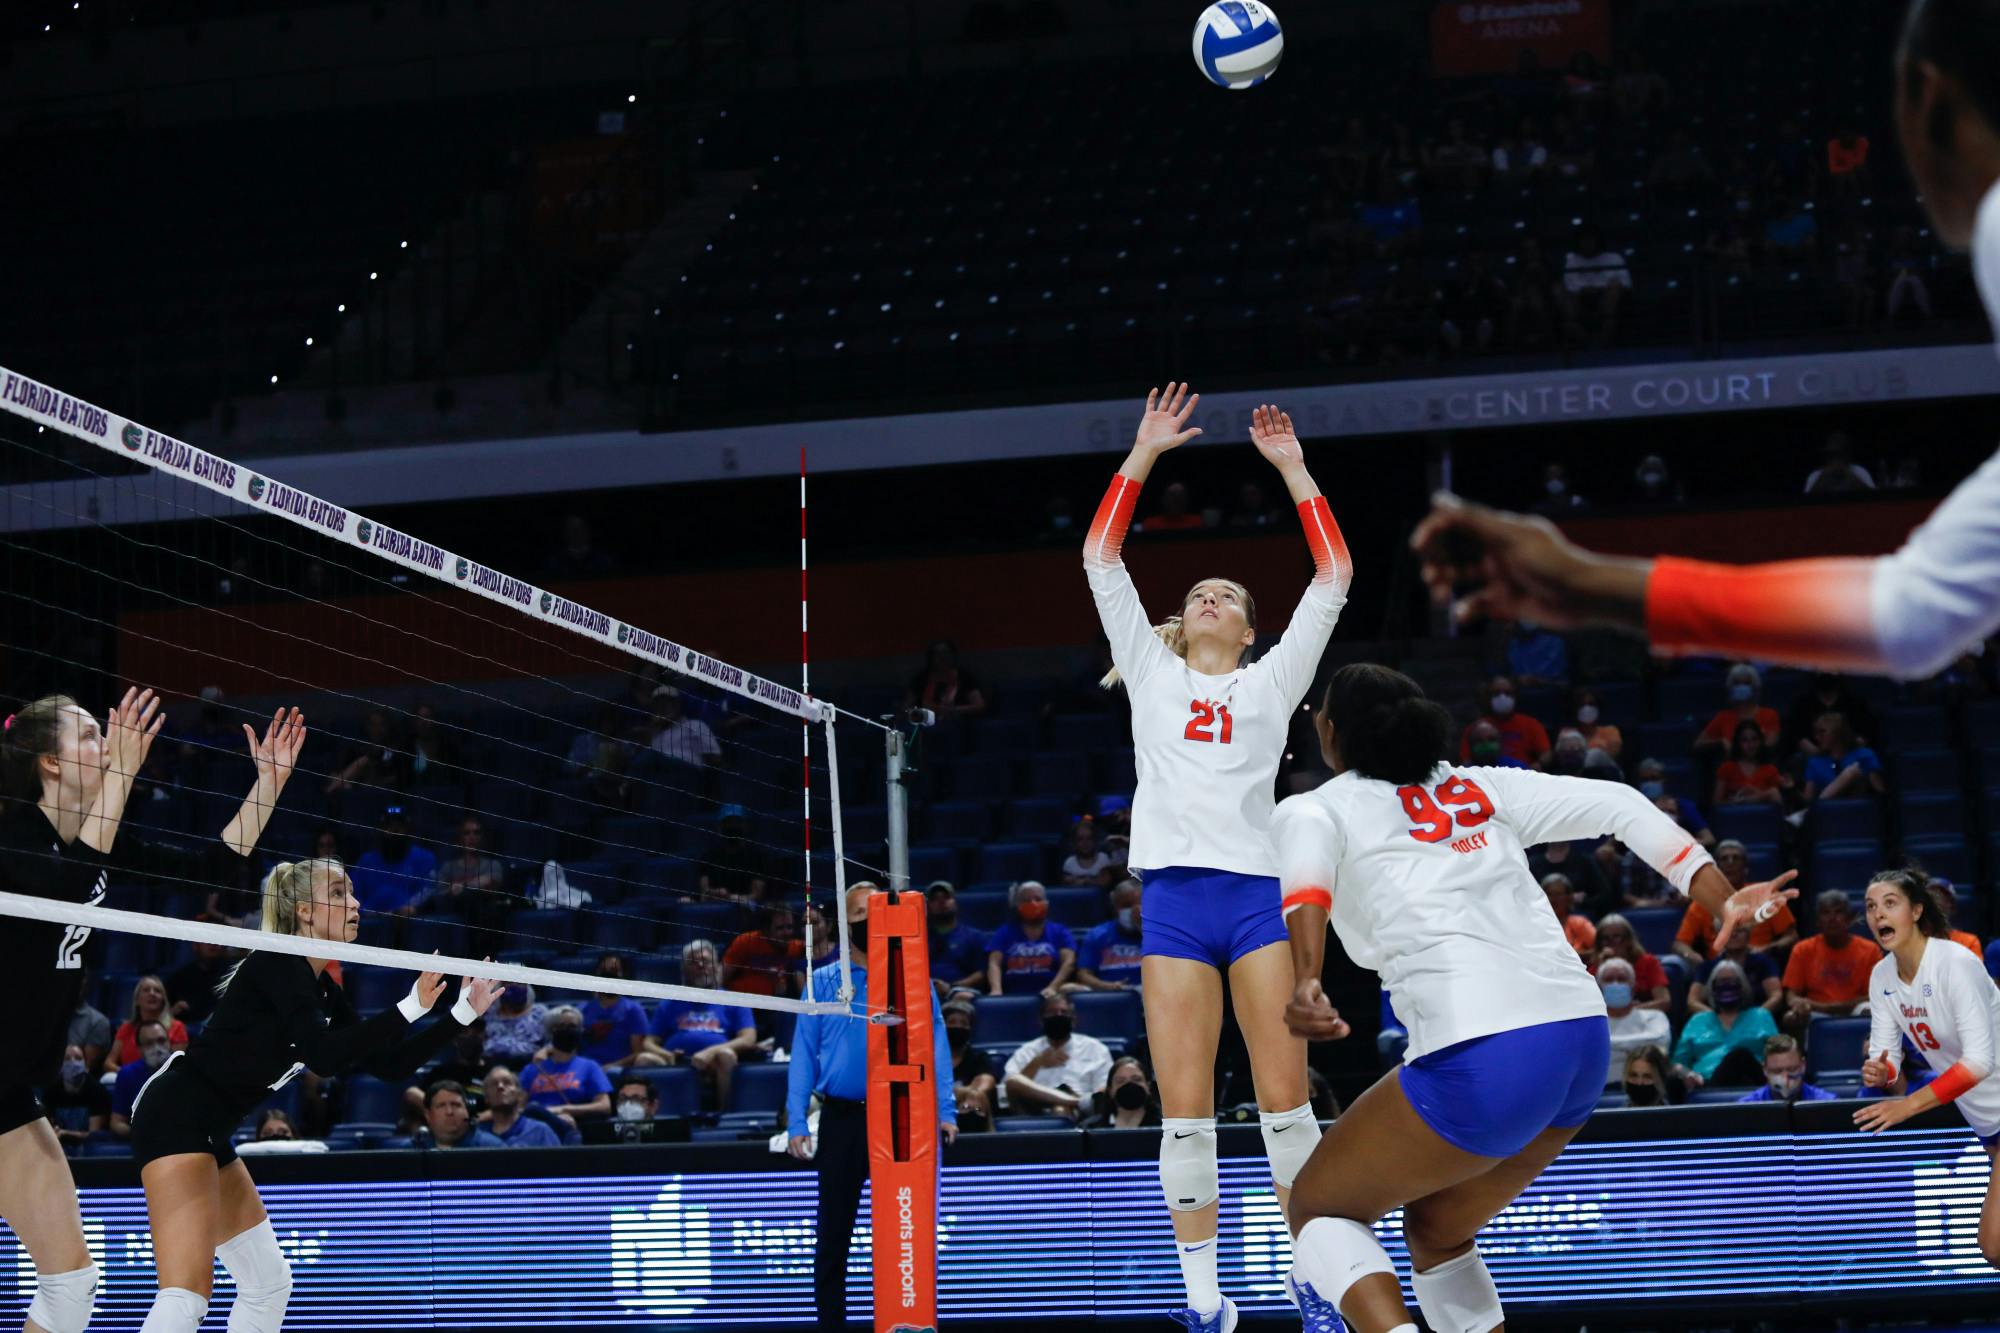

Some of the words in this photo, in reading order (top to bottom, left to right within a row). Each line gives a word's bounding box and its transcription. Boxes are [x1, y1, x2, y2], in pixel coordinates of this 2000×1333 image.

[1481, 18, 1561, 39] ARENA
[3, 374, 57, 418] FLORIDA
[59, 396, 109, 438] GATORS
[1445, 384, 1611, 420] CENTER
[1632, 372, 1777, 408] COURT
[1797, 366, 1909, 398] CLUB
[143, 431, 192, 473] FLORIDA
[193, 454, 236, 489] GATORS
[265, 482, 308, 518] FLORIDA
[308, 499, 347, 533] GATORS
[373, 526, 411, 559] FLORIDA
[412, 542, 445, 571] GATORS
[470, 563, 502, 594] FLORIDA
[502, 577, 532, 605] GATORS
[552, 597, 583, 626] FLORIDA
[1183, 699, 1232, 744] 21
[1396, 775, 1495, 843] 99
[56, 924, 92, 969] 12
[1909, 1023, 1941, 1051] 13
[896, 1187, 915, 1240] sports
[898, 1242, 917, 1308] imports
